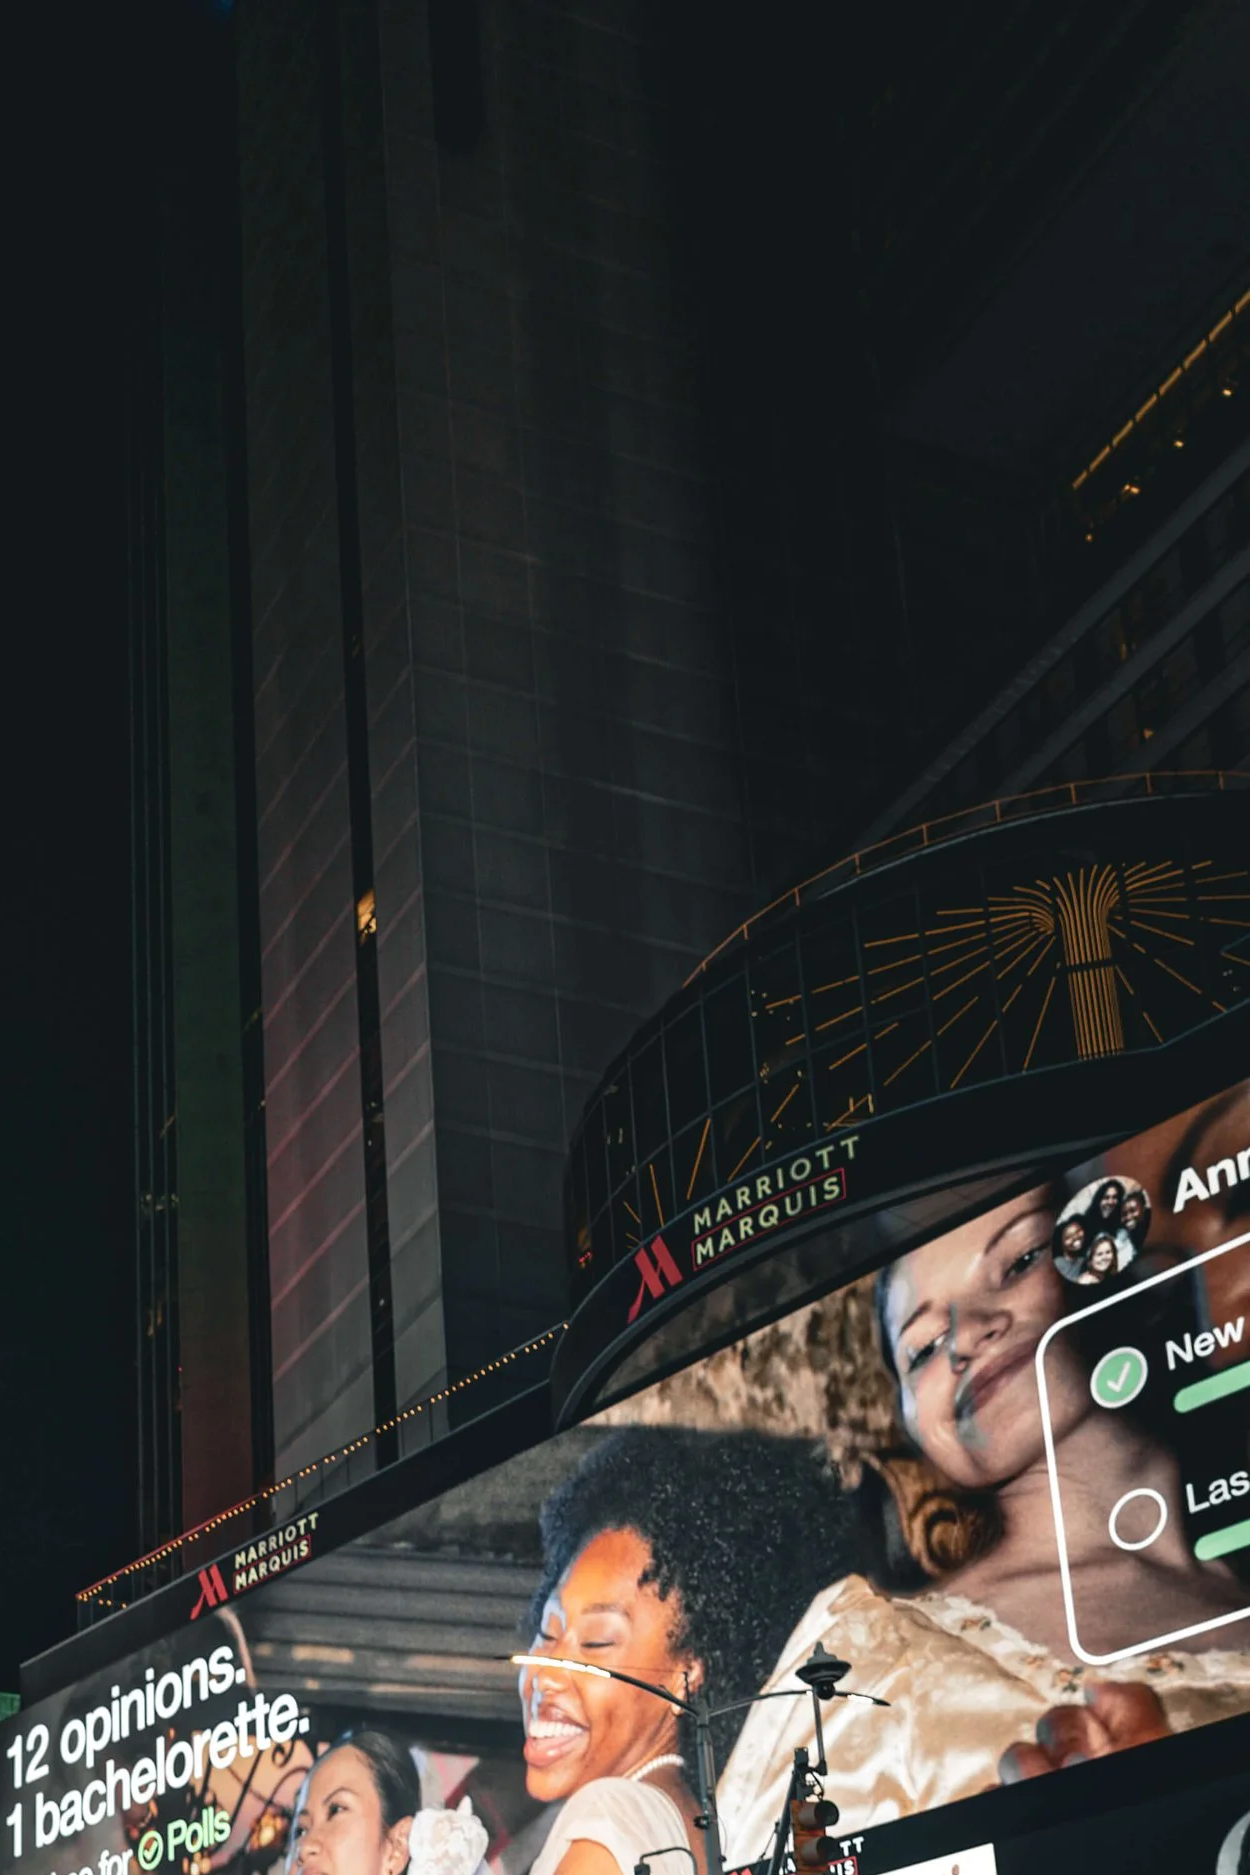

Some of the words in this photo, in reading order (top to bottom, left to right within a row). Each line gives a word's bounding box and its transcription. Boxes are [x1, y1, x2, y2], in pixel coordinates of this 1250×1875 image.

[693, 1136, 860, 1235] MARRIOTT
[694, 1174, 842, 1266] MARQUIS
[1164, 1316, 1246, 1371] New
[233, 1512, 320, 1570] MARRIOTT
[234, 1539, 311, 1590] MARQUIS
[6, 1723, 49, 1790] 12
[60, 1643, 246, 1769] opinions.
[6, 1805, 23, 1858] 1
[35, 1690, 310, 1848] bachelorette.
[166, 1806, 232, 1862] Polls
